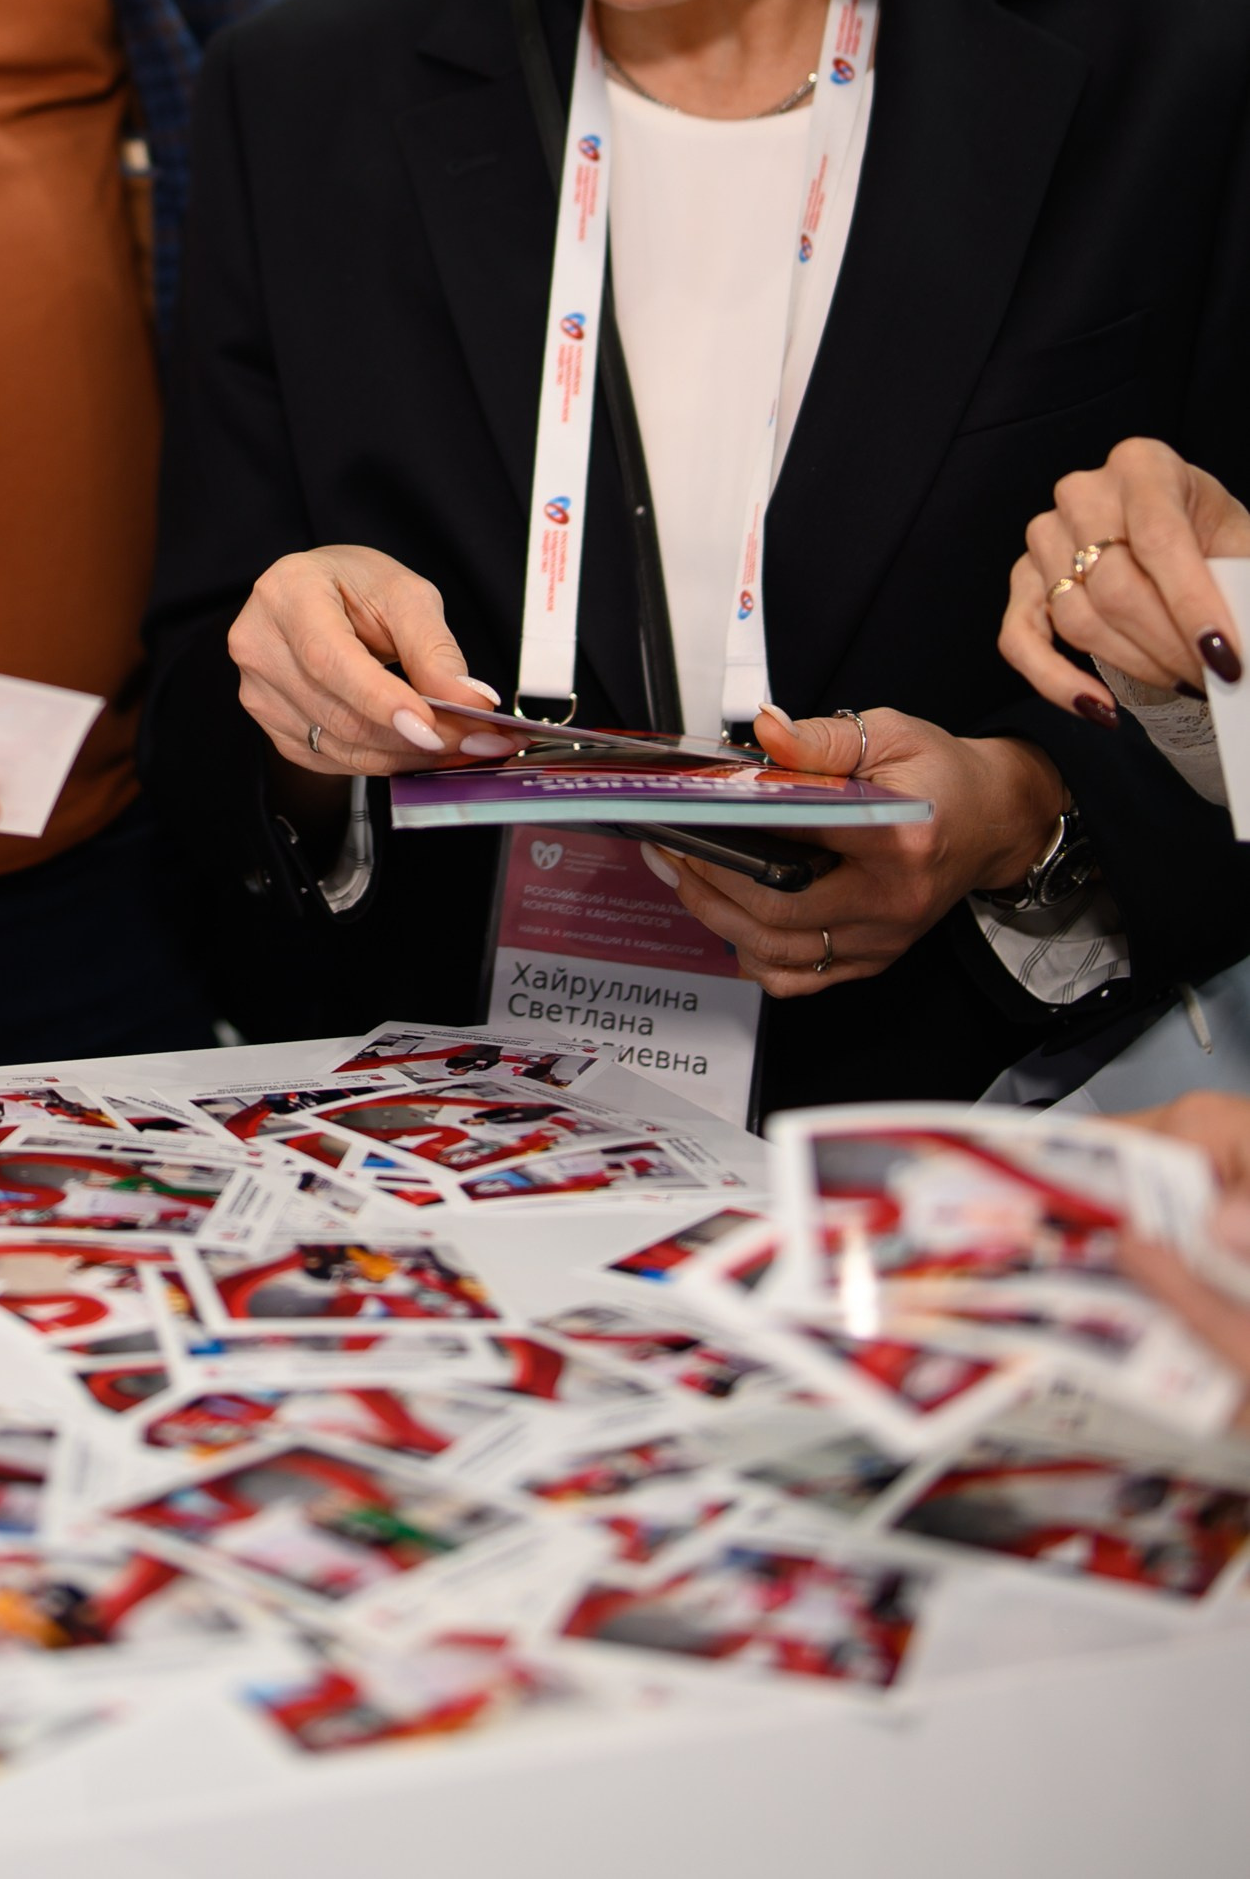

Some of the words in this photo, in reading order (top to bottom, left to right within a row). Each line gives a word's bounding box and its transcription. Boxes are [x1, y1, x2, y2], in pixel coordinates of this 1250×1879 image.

[523, 884, 606, 904] РОССИЙСКИЙ
[521, 899, 583, 917] КОНГРЕСС
[585, 907, 672, 929] КАРДИОЛОГОВ
[511, 961, 698, 1012] Хайруллина
[508, 992, 654, 1036] Светлана
